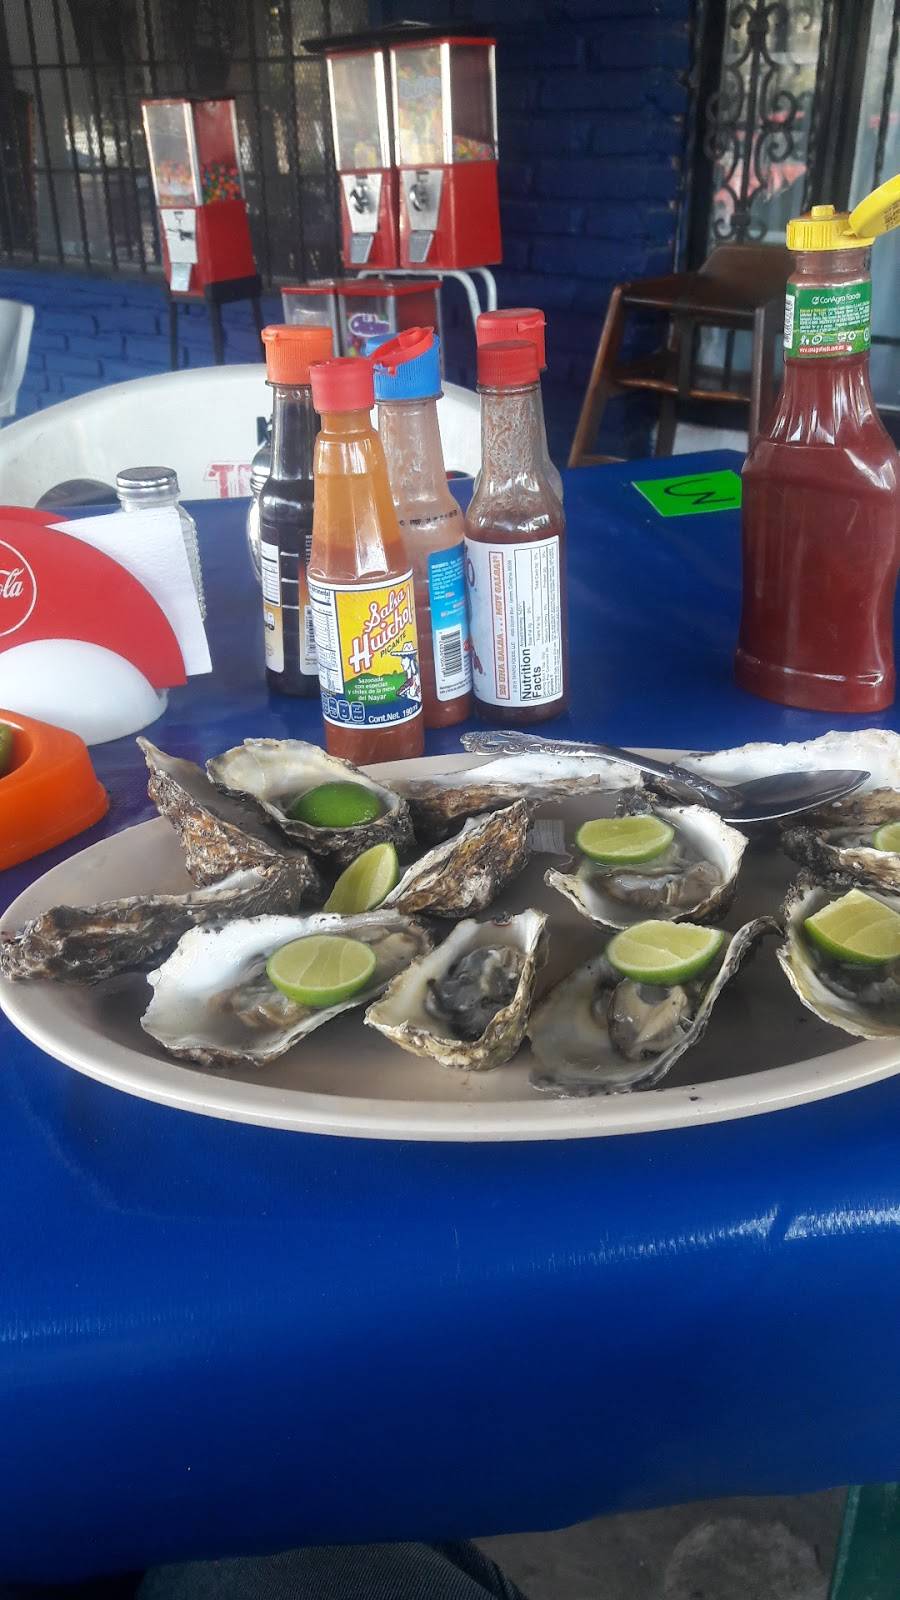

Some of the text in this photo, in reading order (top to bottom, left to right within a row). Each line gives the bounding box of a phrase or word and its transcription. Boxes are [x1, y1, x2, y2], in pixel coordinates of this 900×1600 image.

[349, 583, 412, 673] Huichol
[364, 588, 406, 632] Salsa
[380, 630, 407, 658] PICANTE
[522, 649, 532, 699] Nutrition
[532, 666, 542, 698] Facts
[368, 694, 386, 702] Nayar
